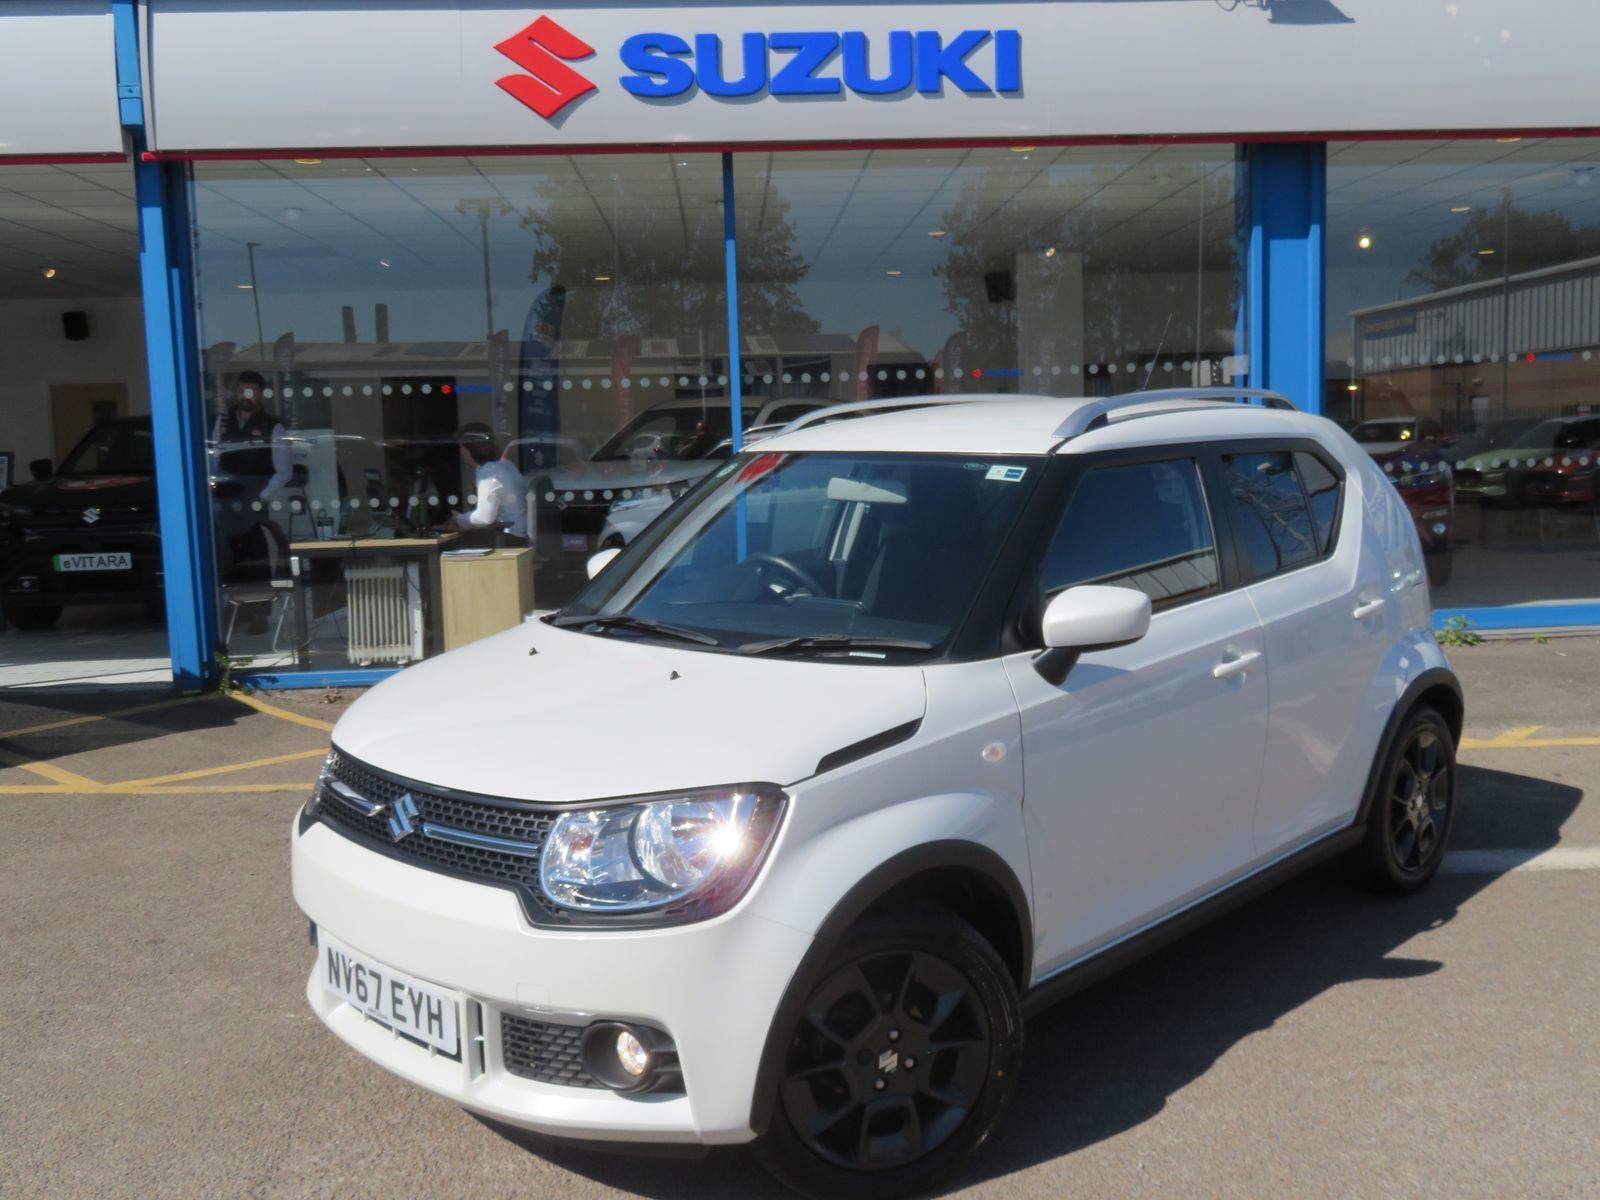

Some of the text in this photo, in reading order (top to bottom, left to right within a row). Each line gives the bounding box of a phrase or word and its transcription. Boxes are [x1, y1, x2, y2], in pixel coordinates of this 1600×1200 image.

[619, 30, 1022, 97] SUZUKI
[63, 555, 128, 569] eVITARA
[328, 947, 443, 1040] NV67 EYH
